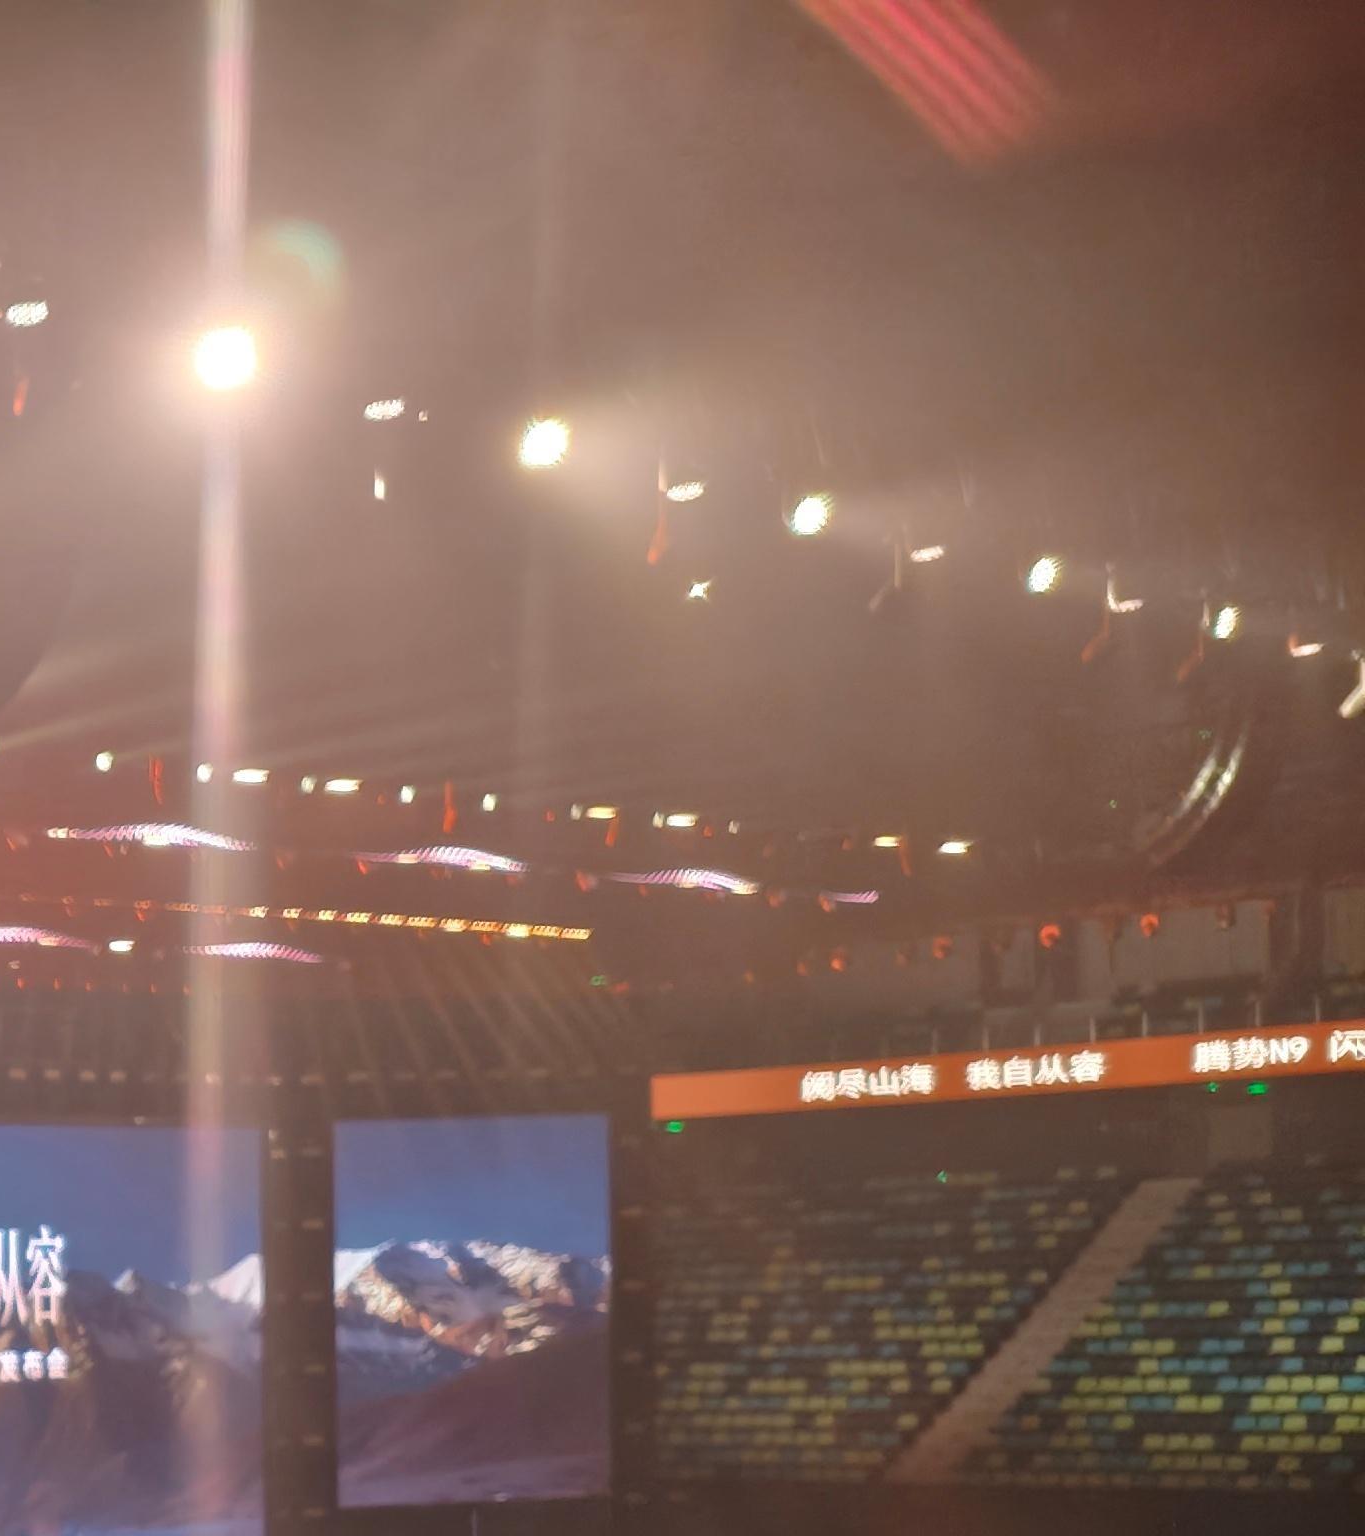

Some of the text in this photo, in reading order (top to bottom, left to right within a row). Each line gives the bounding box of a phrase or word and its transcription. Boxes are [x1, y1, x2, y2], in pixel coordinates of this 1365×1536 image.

[801, 1063, 934, 1102] 阅尽山海
[966, 1050, 1105, 1091] 我自从容
